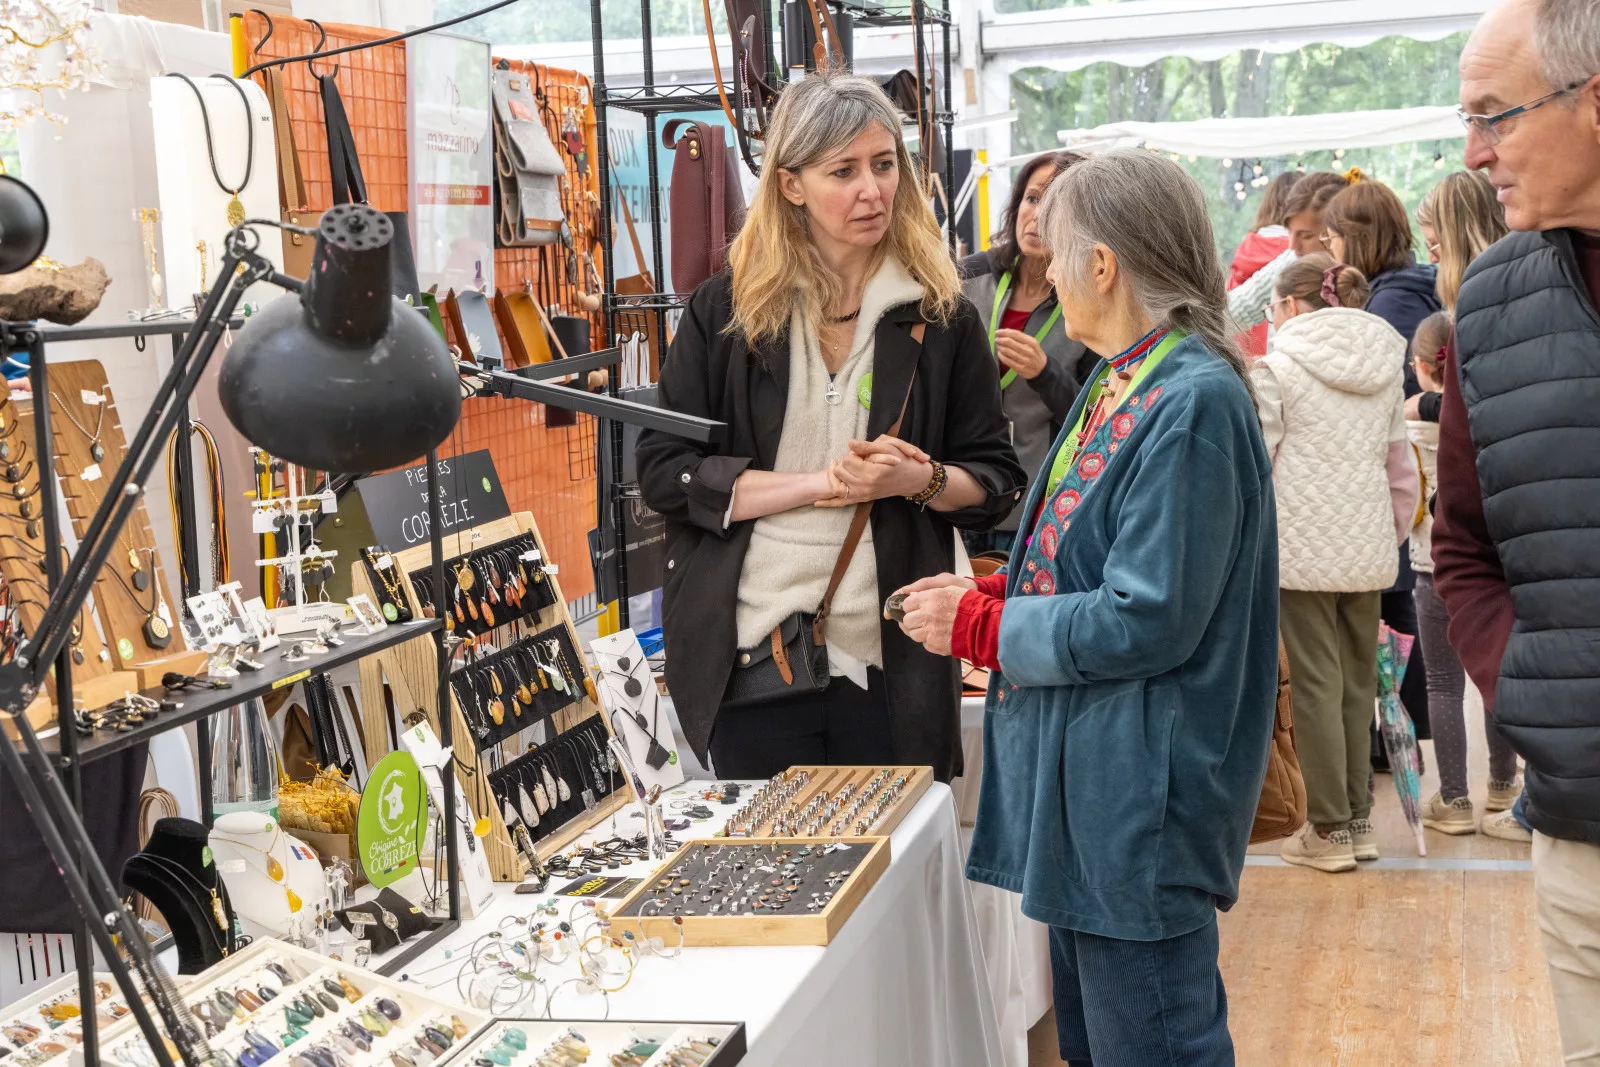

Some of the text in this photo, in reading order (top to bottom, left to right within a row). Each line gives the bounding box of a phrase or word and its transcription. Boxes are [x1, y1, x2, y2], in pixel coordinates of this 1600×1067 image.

[609, 128, 639, 167] OUX
[402, 499, 474, 543] CORÈZE
[369, 837, 398, 859] Origine
